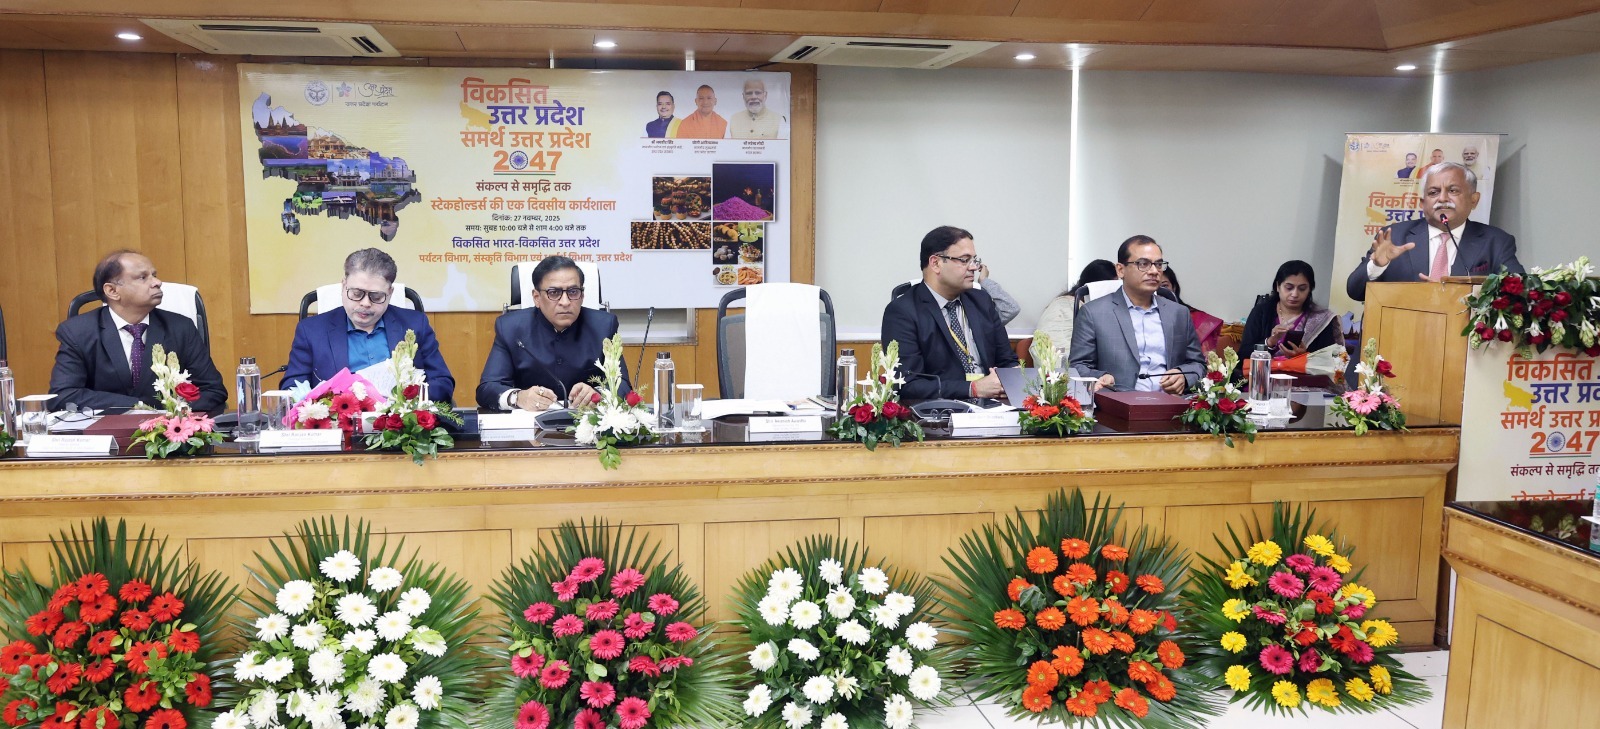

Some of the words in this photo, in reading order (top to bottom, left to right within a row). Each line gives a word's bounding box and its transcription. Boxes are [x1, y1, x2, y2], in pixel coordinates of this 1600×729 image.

[461, 77, 549, 104] विकसित
[487, 105, 529, 126] उत्तर
[534, 100, 585, 126] प्रदेश
[460, 126, 505, 148] समर्थ
[509, 131, 544, 148] उत्तर
[548, 127, 591, 148] प्रदेश
[476, 179, 508, 192] संकल्प
[511, 180, 519, 192] से
[522, 179, 551, 195] समृद्धि
[554, 182, 572, 192] तक
[431, 197, 487, 211] स्टेकहोल्डर्स
[489, 197, 504, 211] की
[507, 200, 525, 211] एक
[527, 197, 566, 211] दिवसीय
[568, 197, 616, 211] कार्यशाला
[452, 237, 490, 249] विकसित
[559, 240, 576, 248] उत्तर
[578, 237, 600, 248] प्रदेश
[419, 252, 443, 263] पर्यटन
[444, 252, 471, 264] विभाग,
[474, 252, 502, 266] संस्कृति
[504, 252, 528, 263] विभाग
[530, 253, 543, 262] एवं
[596, 254, 612, 262] उत्तर
[614, 252, 632, 262] प्रदेश
[1507, 353, 1595, 381] विकसित
[1530, 383, 1572, 404] उत्तर
[1500, 405, 1546, 430] समर्थ
[1549, 410, 1584, 428] उत्तर
[1510, 464, 1543, 477] संकल्प
[1545, 462, 1554, 476] से
[1556, 461, 1586, 479] समृद्धि
